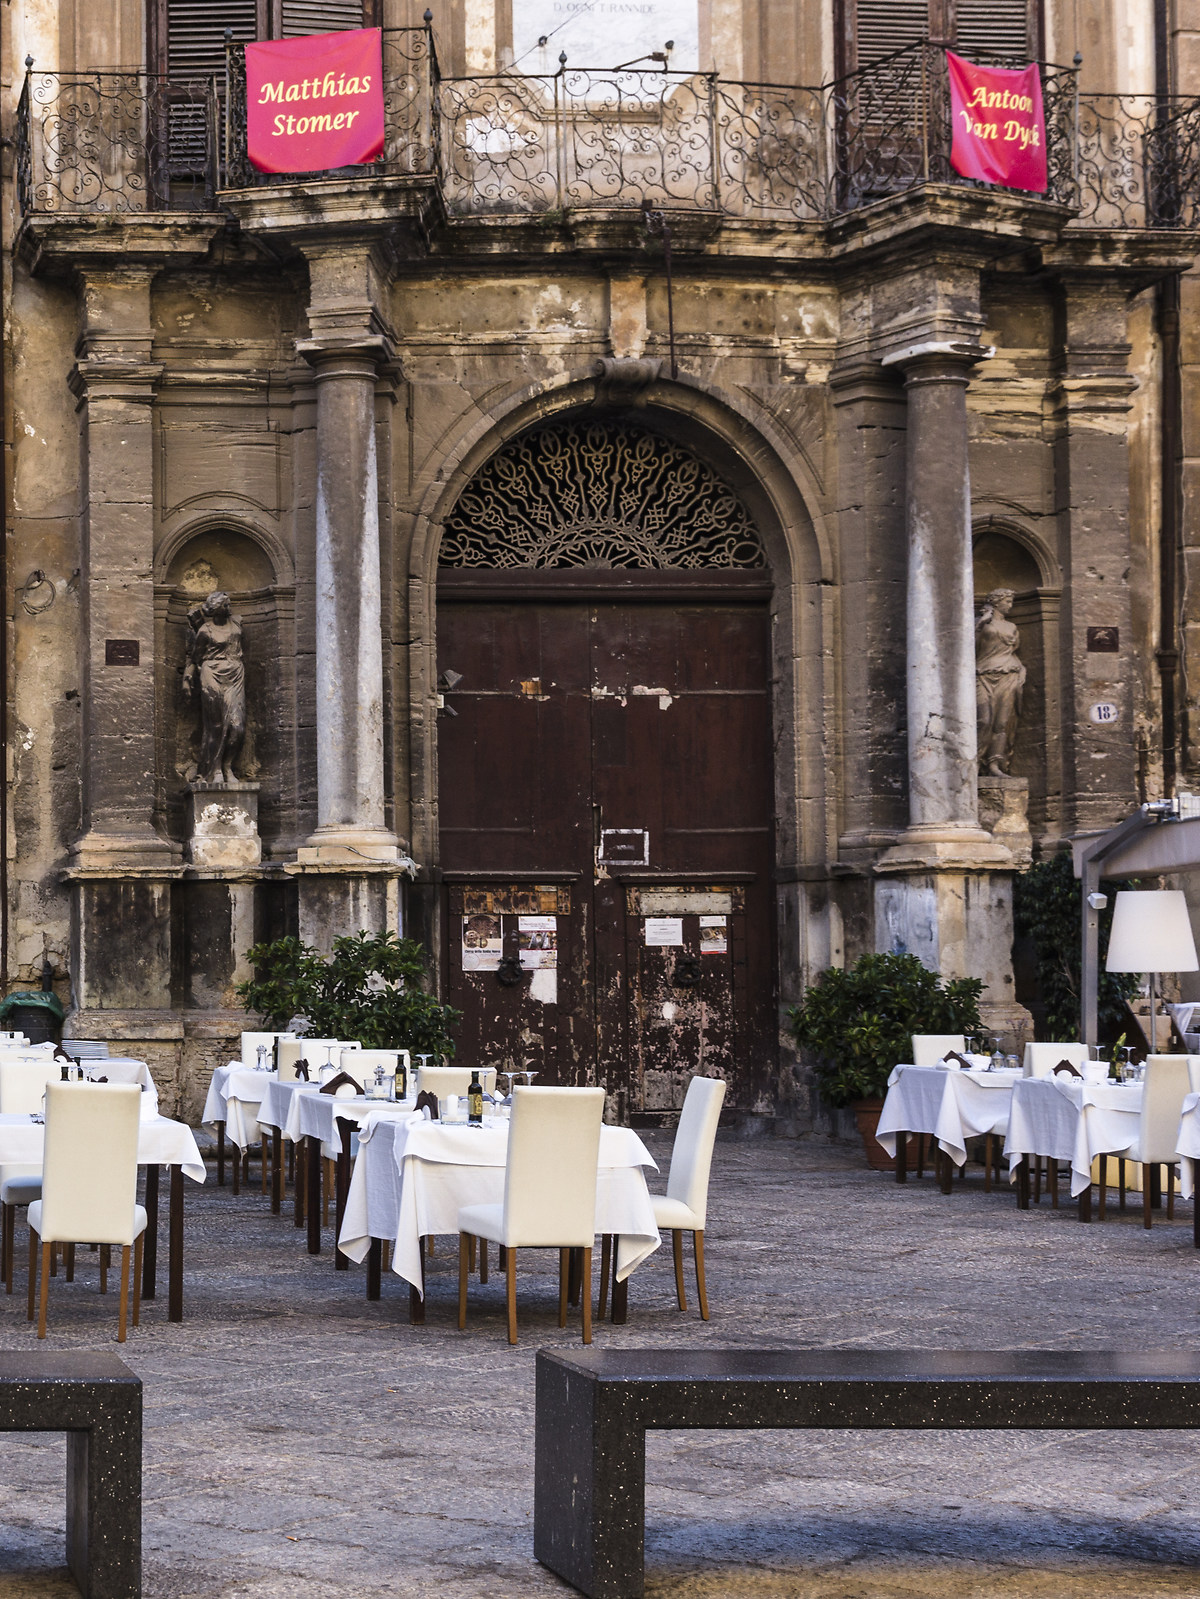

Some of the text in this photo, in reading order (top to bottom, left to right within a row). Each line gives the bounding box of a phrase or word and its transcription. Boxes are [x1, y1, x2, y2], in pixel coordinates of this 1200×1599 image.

[599, 3, 657, 14] TRANNIDE
[257, 71, 372, 104] Matthias
[966, 86, 1033, 113] Antoon
[271, 111, 360, 137] Stomer
[959, 110, 998, 139] Van
[1097, 705, 1111, 720] 18
